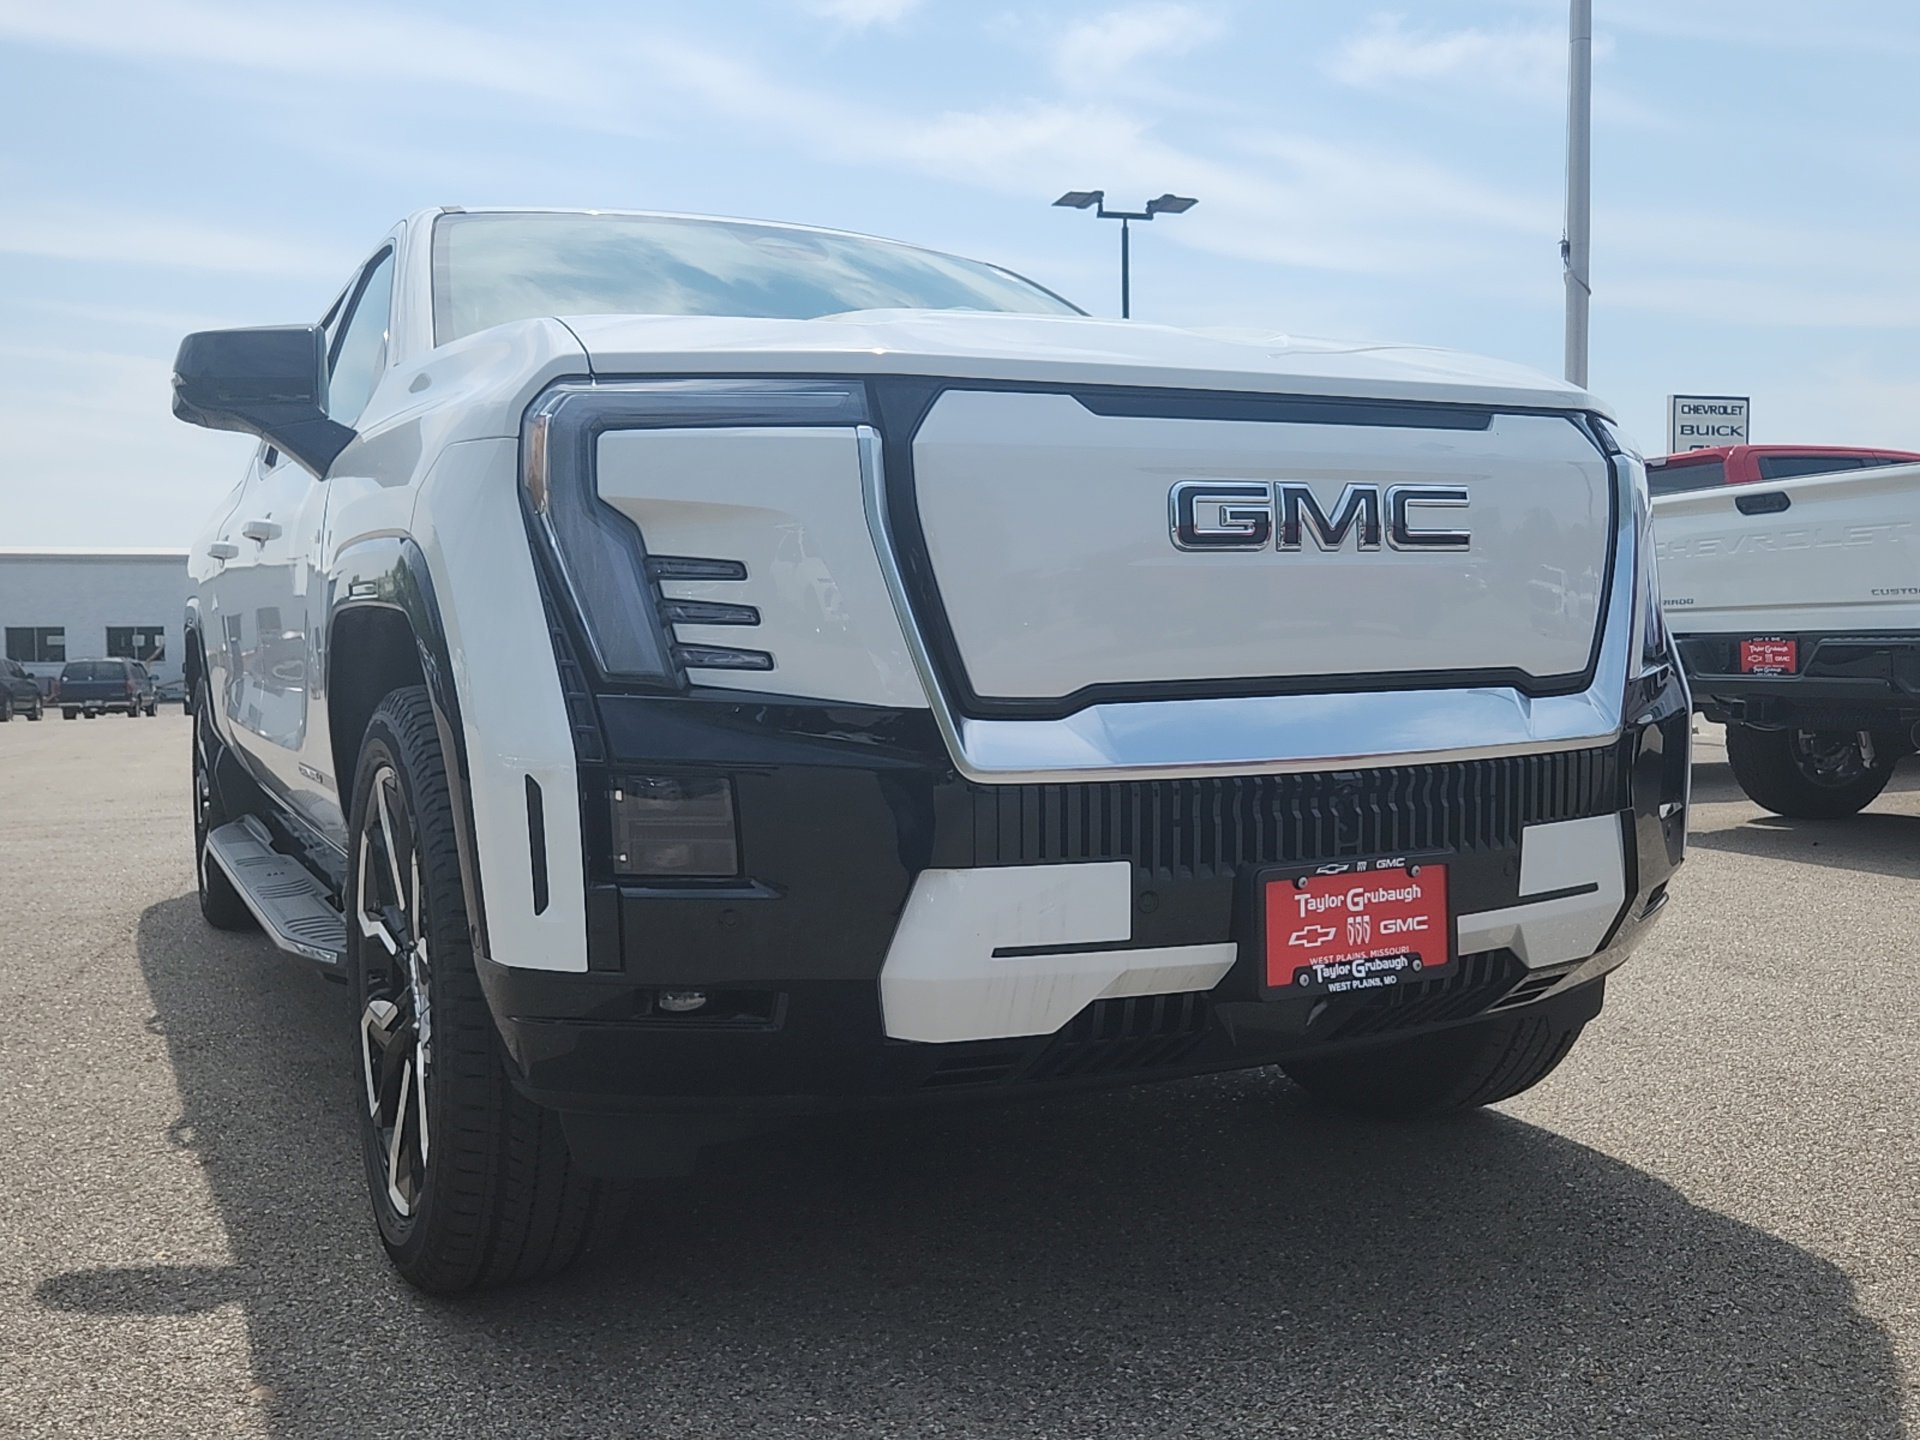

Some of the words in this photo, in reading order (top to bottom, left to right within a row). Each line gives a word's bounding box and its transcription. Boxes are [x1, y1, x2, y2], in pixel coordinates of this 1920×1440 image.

[1681, 404, 1744, 416] CHEVROLET
[1680, 424, 1744, 437] BUICK
[1168, 480, 1471, 552] GMC
[1871, 587, 1920, 596] CUSTO
[1376, 857, 1406, 869] GMC
[1294, 893, 1345, 918] Taylor
[1346, 884, 1421, 912] Grubaugh
[1380, 915, 1429, 934] GMC
[1309, 954, 1334, 965] WEST
[1370, 945, 1410, 958] MISSOURI
[1312, 962, 1351, 984] Taylor
[1352, 954, 1408, 978] Grubaugh
[1327, 980, 1352, 993] WEST
[1352, 977, 1384, 990] PLAINS,
[1384, 975, 1397, 985] MO
